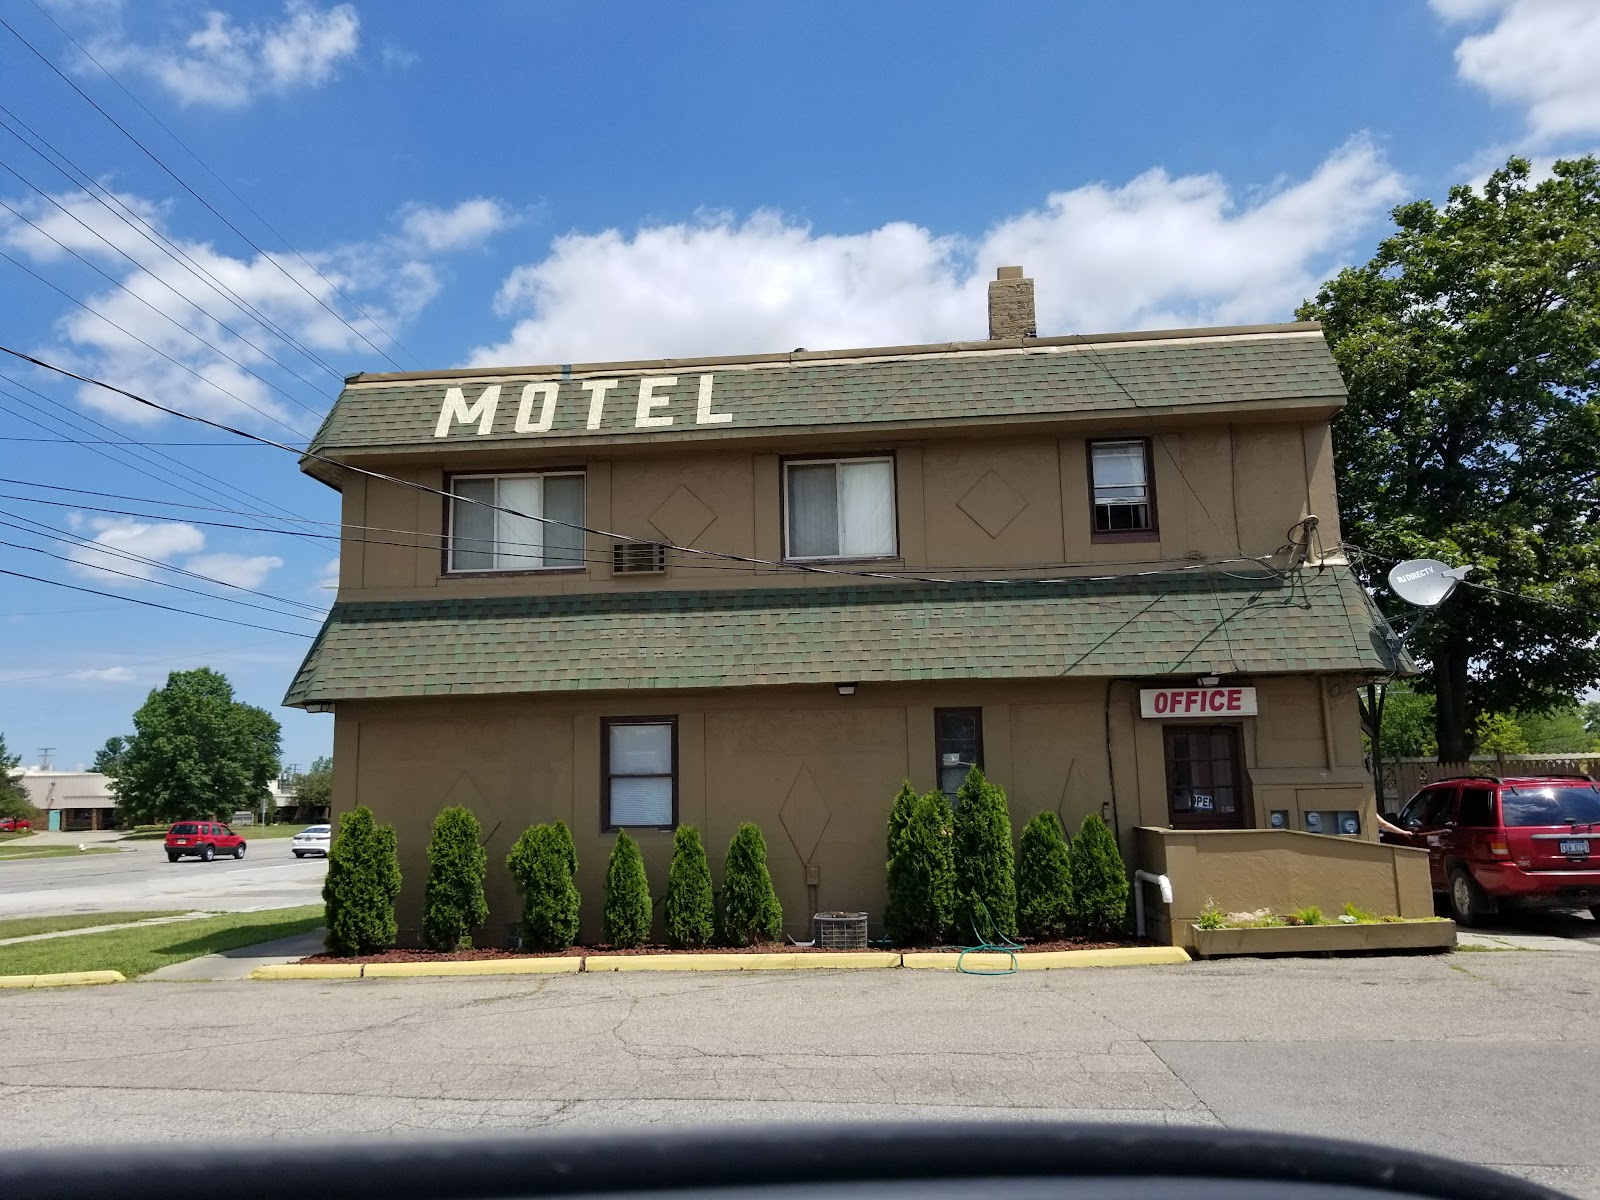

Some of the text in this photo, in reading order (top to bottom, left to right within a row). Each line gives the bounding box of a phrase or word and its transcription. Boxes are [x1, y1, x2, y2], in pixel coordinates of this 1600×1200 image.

[434, 374, 733, 438] MOTEL
[1405, 566, 1434, 581] DIRECTV
[1154, 689, 1242, 713] OFFICE
